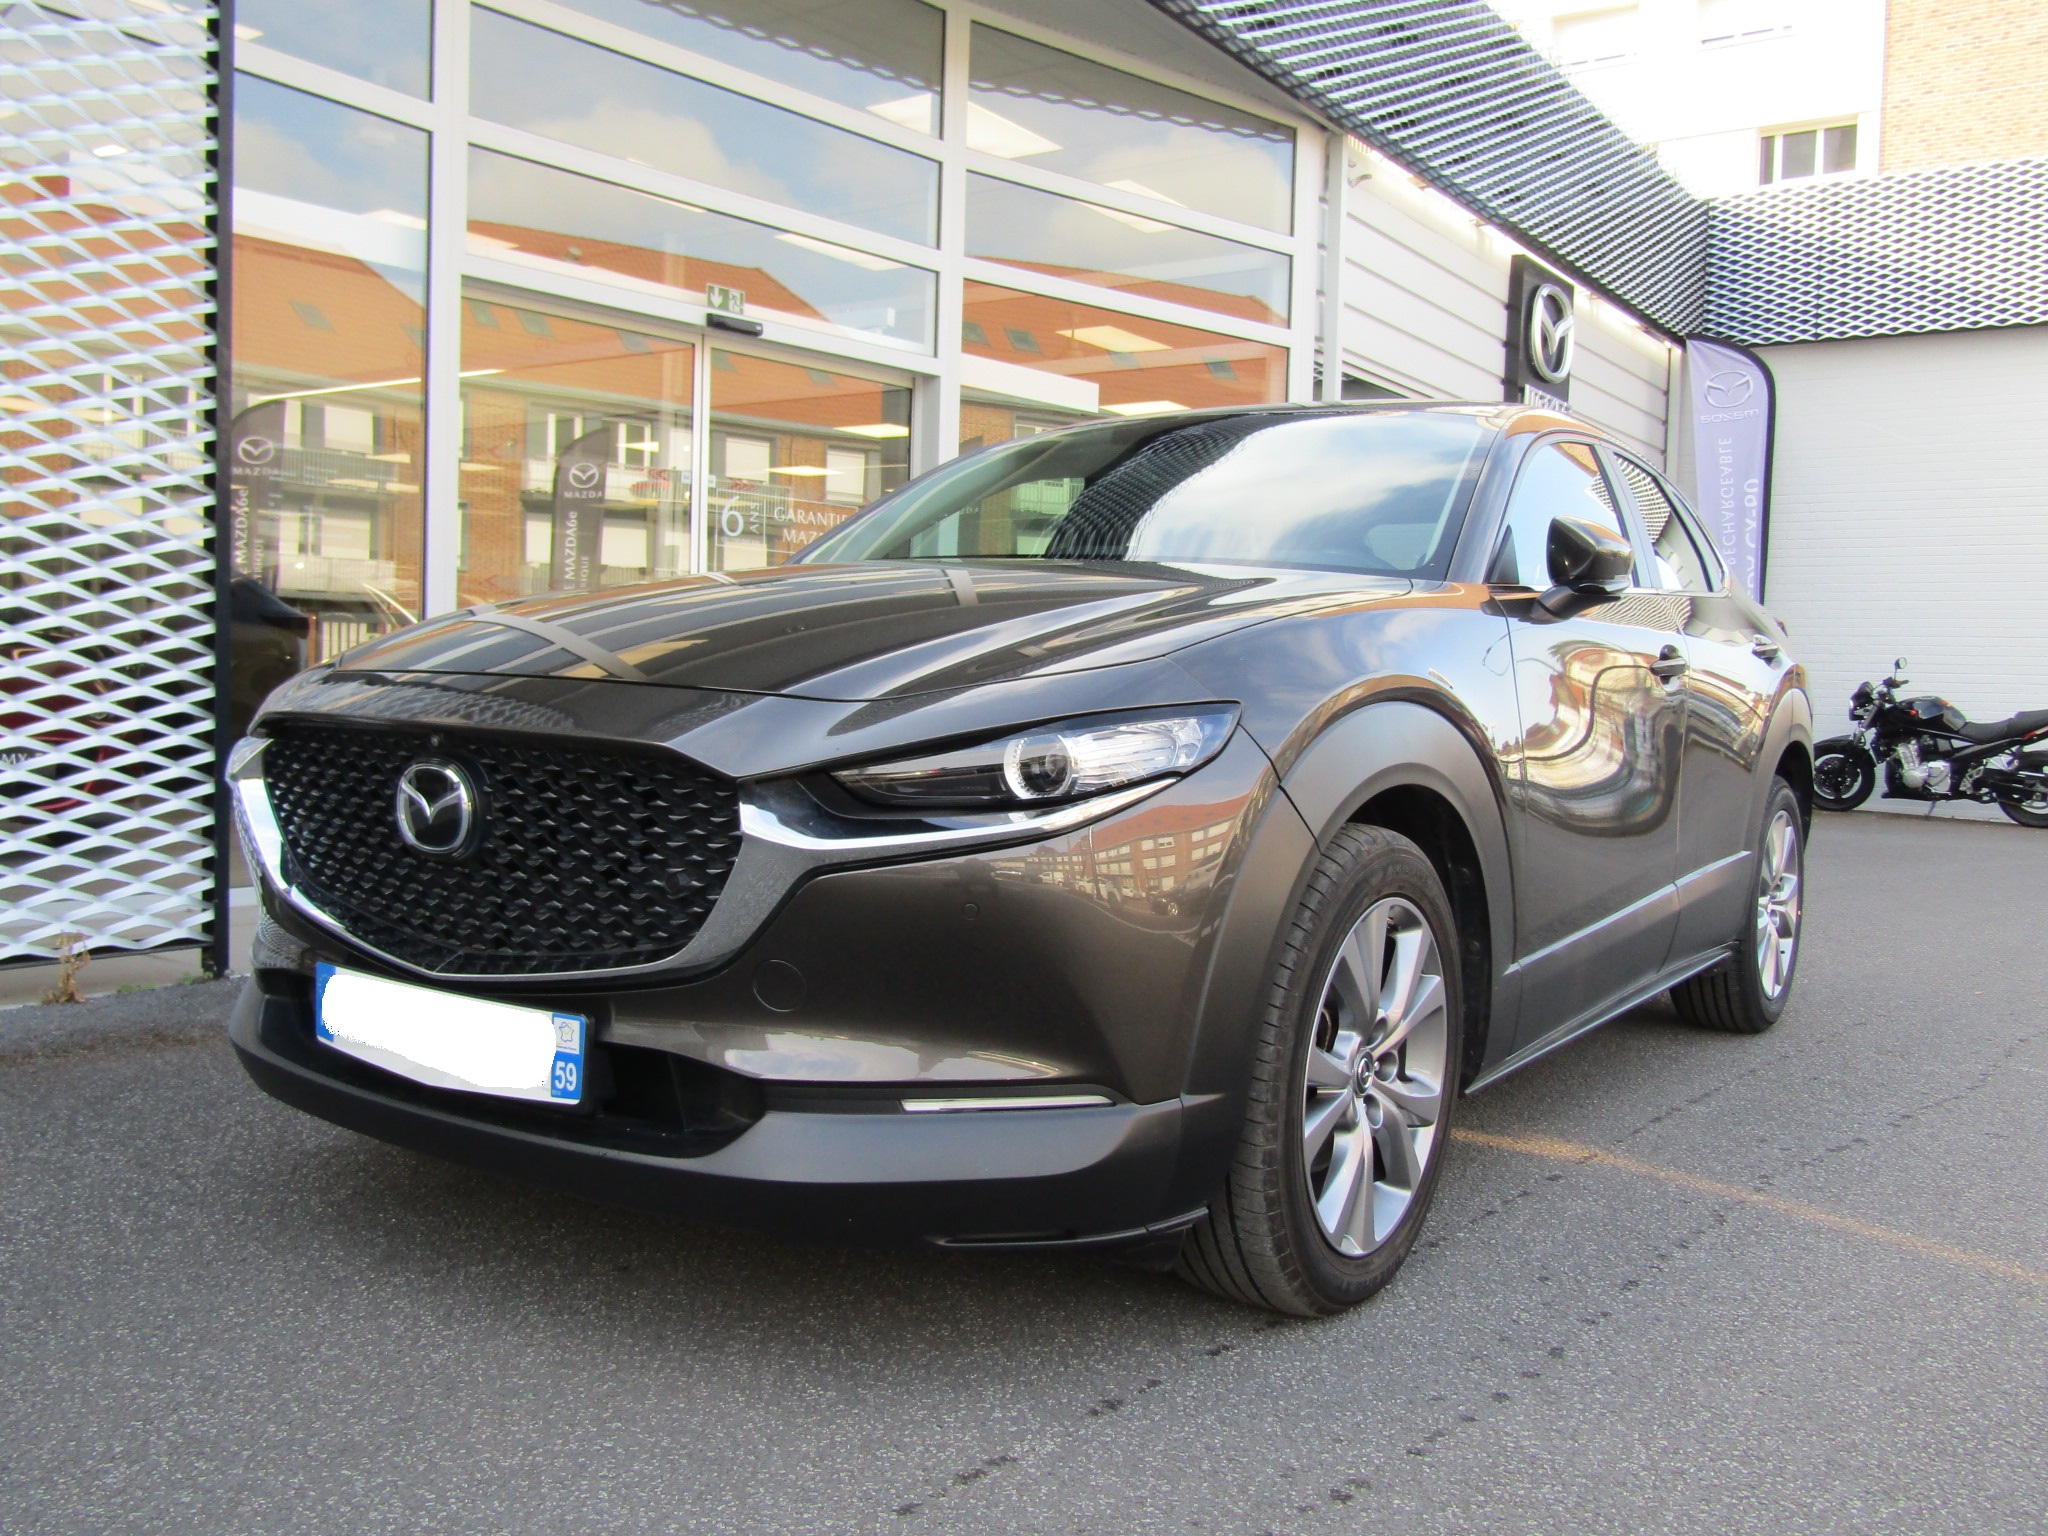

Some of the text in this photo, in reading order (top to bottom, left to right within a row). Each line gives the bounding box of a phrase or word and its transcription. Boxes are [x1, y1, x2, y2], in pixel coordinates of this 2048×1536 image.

[563, 491, 604, 499] MAZDA
[721, 496, 744, 537] 6
[750, 502, 761, 535] ANS
[564, 511, 578, 580] MAZDA6e
[555, 1060, 578, 1091] 59
